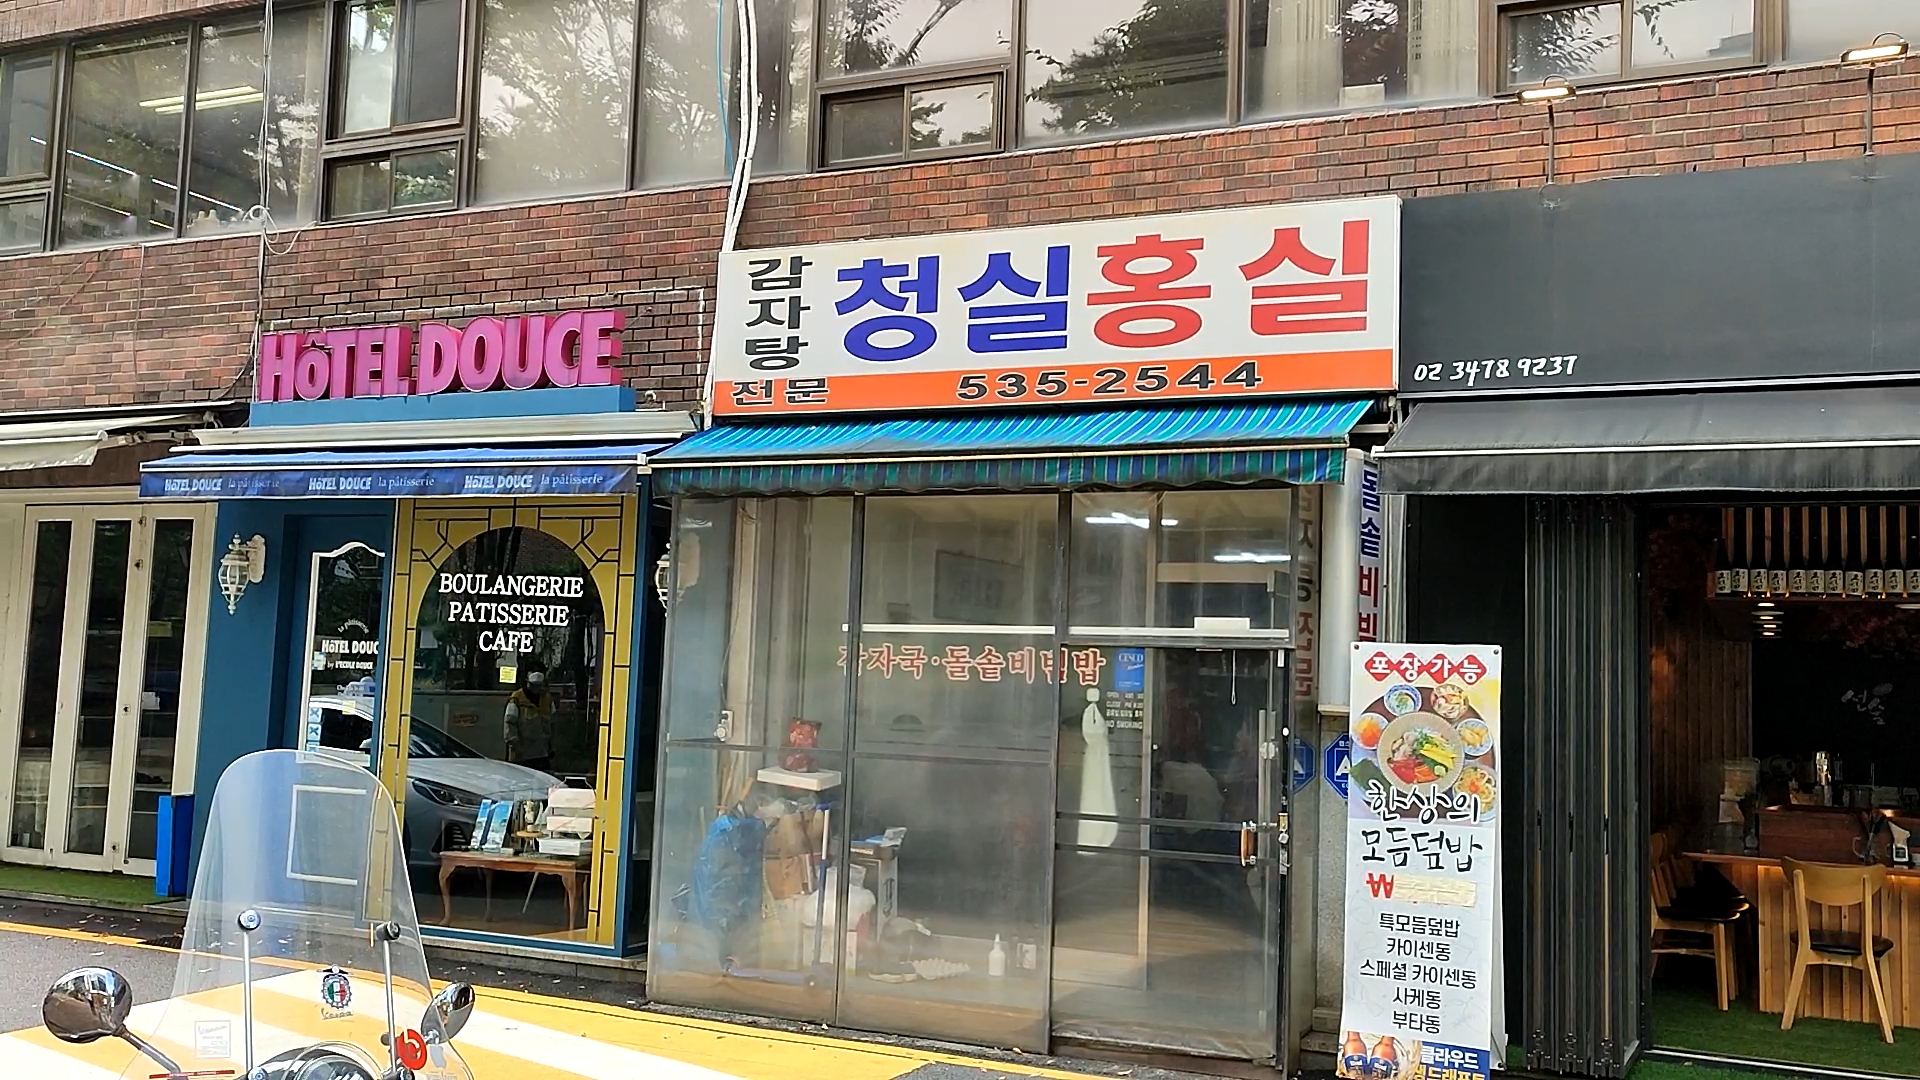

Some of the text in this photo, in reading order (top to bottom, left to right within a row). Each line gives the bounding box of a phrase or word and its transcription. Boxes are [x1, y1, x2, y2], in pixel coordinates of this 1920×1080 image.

[834, 220, 1370, 361] 청실홍실
[745, 256, 813, 370] 감자탕
[417, 309, 625, 395] DOUCE
[956, 361, 1262, 400] 535-2544
[1413, 355, 1578, 387] 02 3478 9237
[732, 378, 829, 405] 전문
[192, 479, 222, 491] DOUCE
[340, 477, 372, 490] DOUCE
[497, 475, 534, 488] DOUCE
[438, 573, 584, 598] BOULANGERIE
[447, 601, 570, 627] PATISSERIE
[479, 630, 534, 653] CAFE
[1369, 656, 1482, 683] 포장가능
[1367, 779, 1480, 824] 한상의
[1361, 827, 1483, 872] 모듬덮밥
[1379, 912, 1460, 938] 특모듬덮밥
[1386, 937, 1451, 962] 카이센동
[1360, 959, 1477, 989] 스페셜 카이센동
[1392, 986, 1441, 1010] 사케동
[1392, 1010, 1441, 1034] 부타동
[1420, 1045, 1480, 1069] 클라우드
